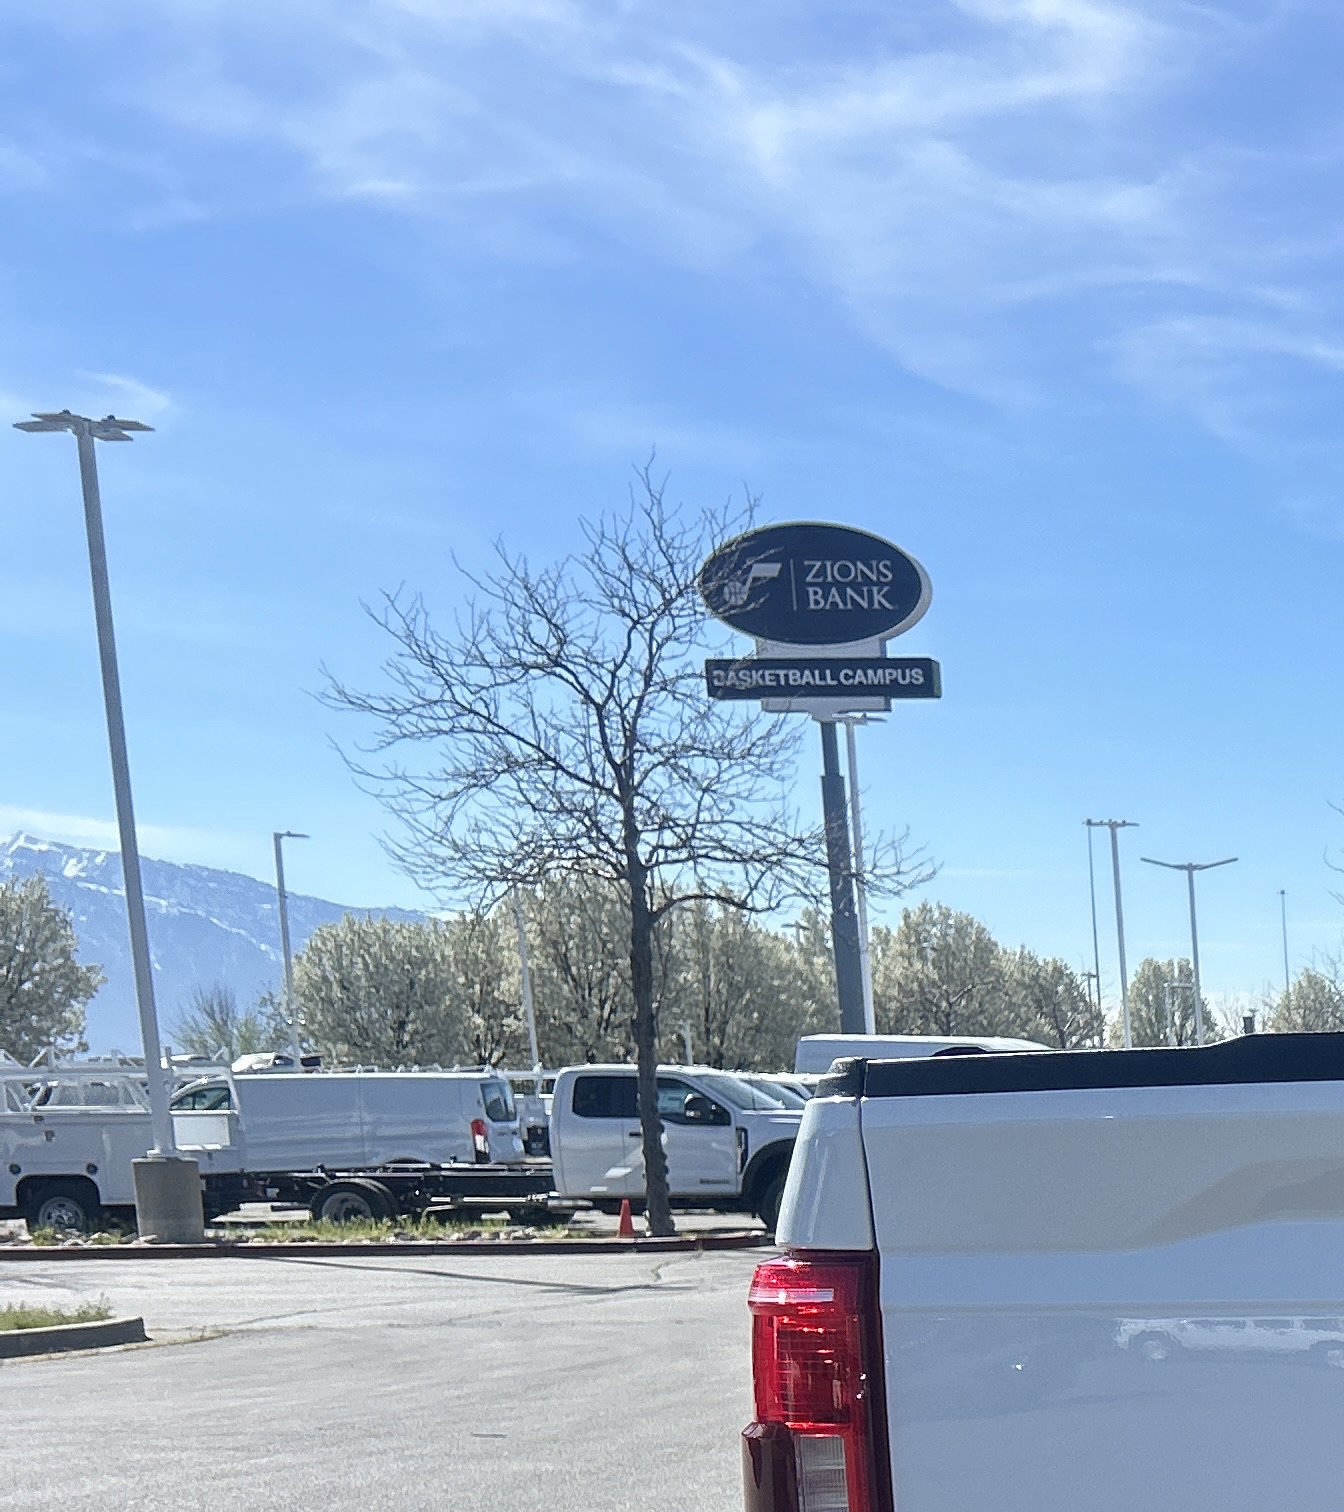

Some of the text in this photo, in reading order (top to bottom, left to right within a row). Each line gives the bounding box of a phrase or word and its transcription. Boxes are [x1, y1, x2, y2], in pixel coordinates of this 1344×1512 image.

[803, 559, 893, 583] ZIONS
[806, 585, 896, 611] BANK
[712, 667, 925, 688] BASKETBALL CAMPUS
